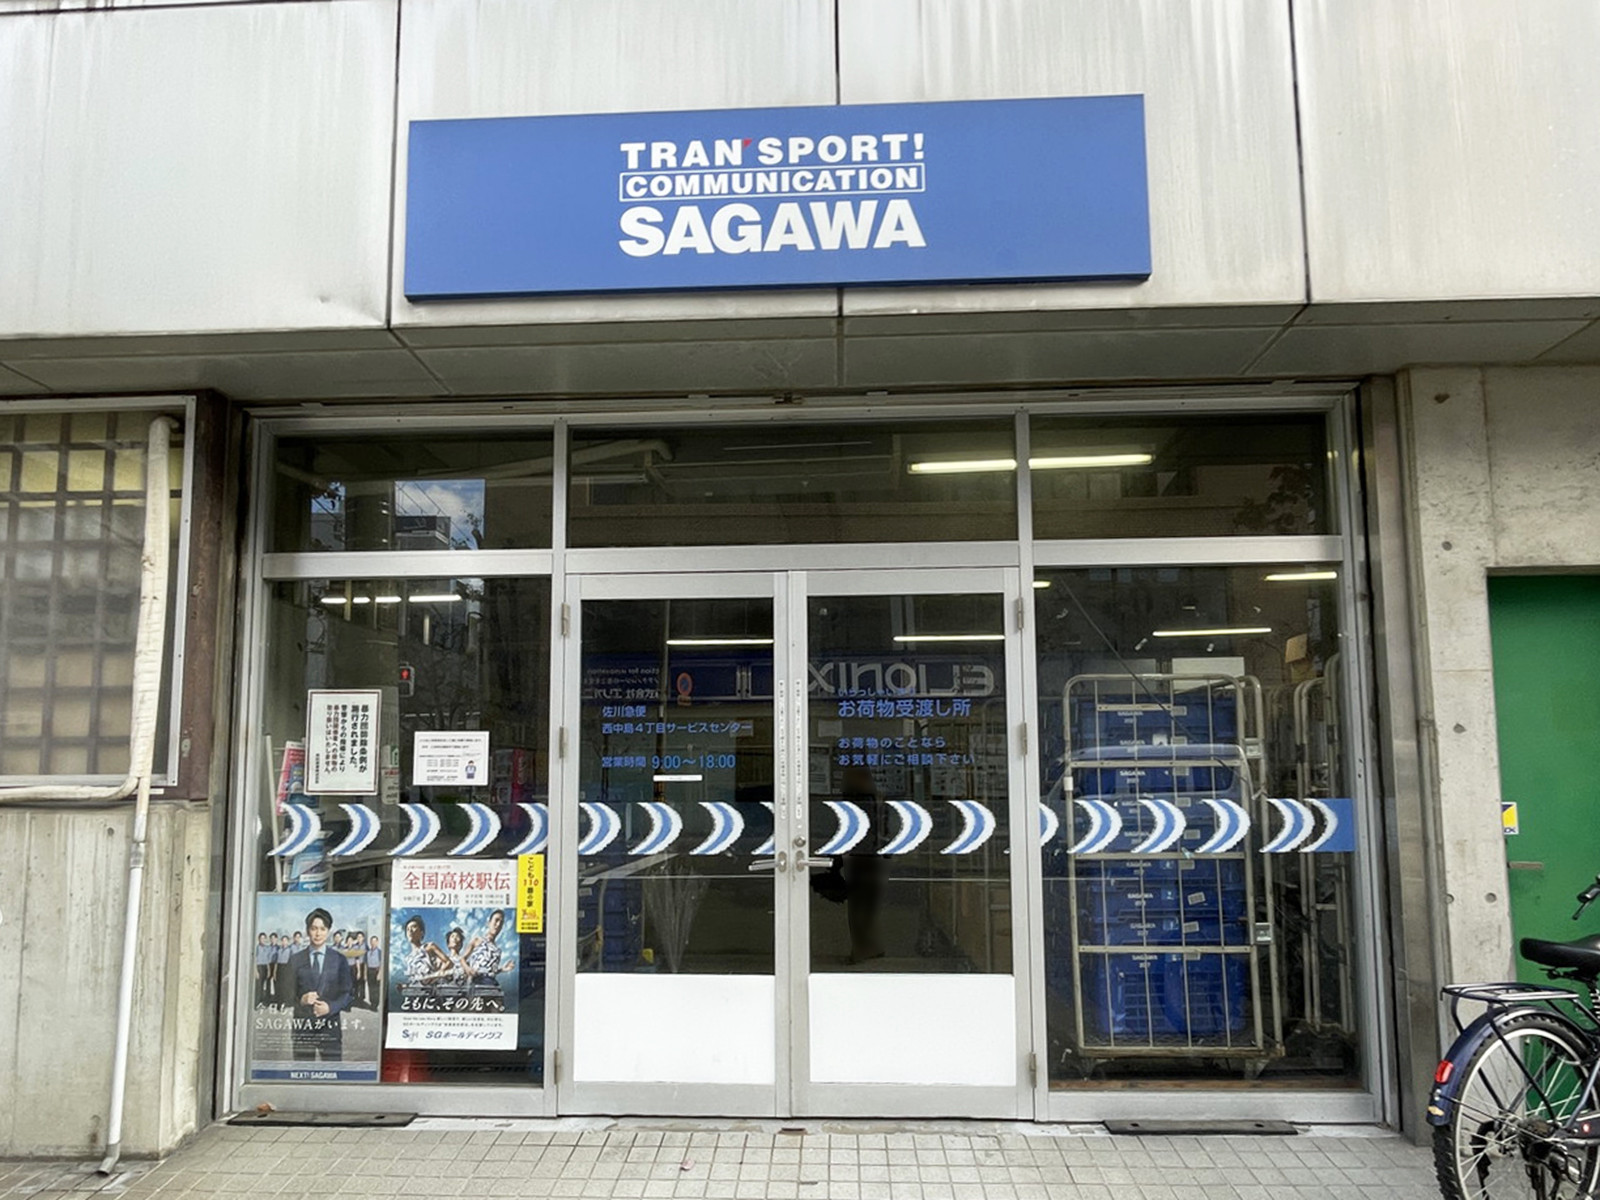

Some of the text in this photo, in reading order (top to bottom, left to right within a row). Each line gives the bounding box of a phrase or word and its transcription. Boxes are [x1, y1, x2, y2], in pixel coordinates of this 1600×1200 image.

[625, 167, 918, 198] COMMUNICATION
[618, 199, 927, 257] SAGAWA
[602, 705, 647, 718] 佐川急便
[838, 698, 971, 718] お荷物受渡し所
[602, 722, 753, 734] 西中島4丁目サービスセンター
[838, 736, 946, 749] お荷物のことなら
[602, 756, 646, 768] 営業時間
[838, 753, 975, 766] お気軽にご相談下さい
[403, 871, 511, 890] 全国高校駅伝
[400, 997, 506, 1012] ともに、その先へ。
[255, 1018, 366, 1031] SAGAWAがいます。
[425, 1030, 504, 1040] SGホールディングス
[310, 1071, 338, 1080] SAGAWA
